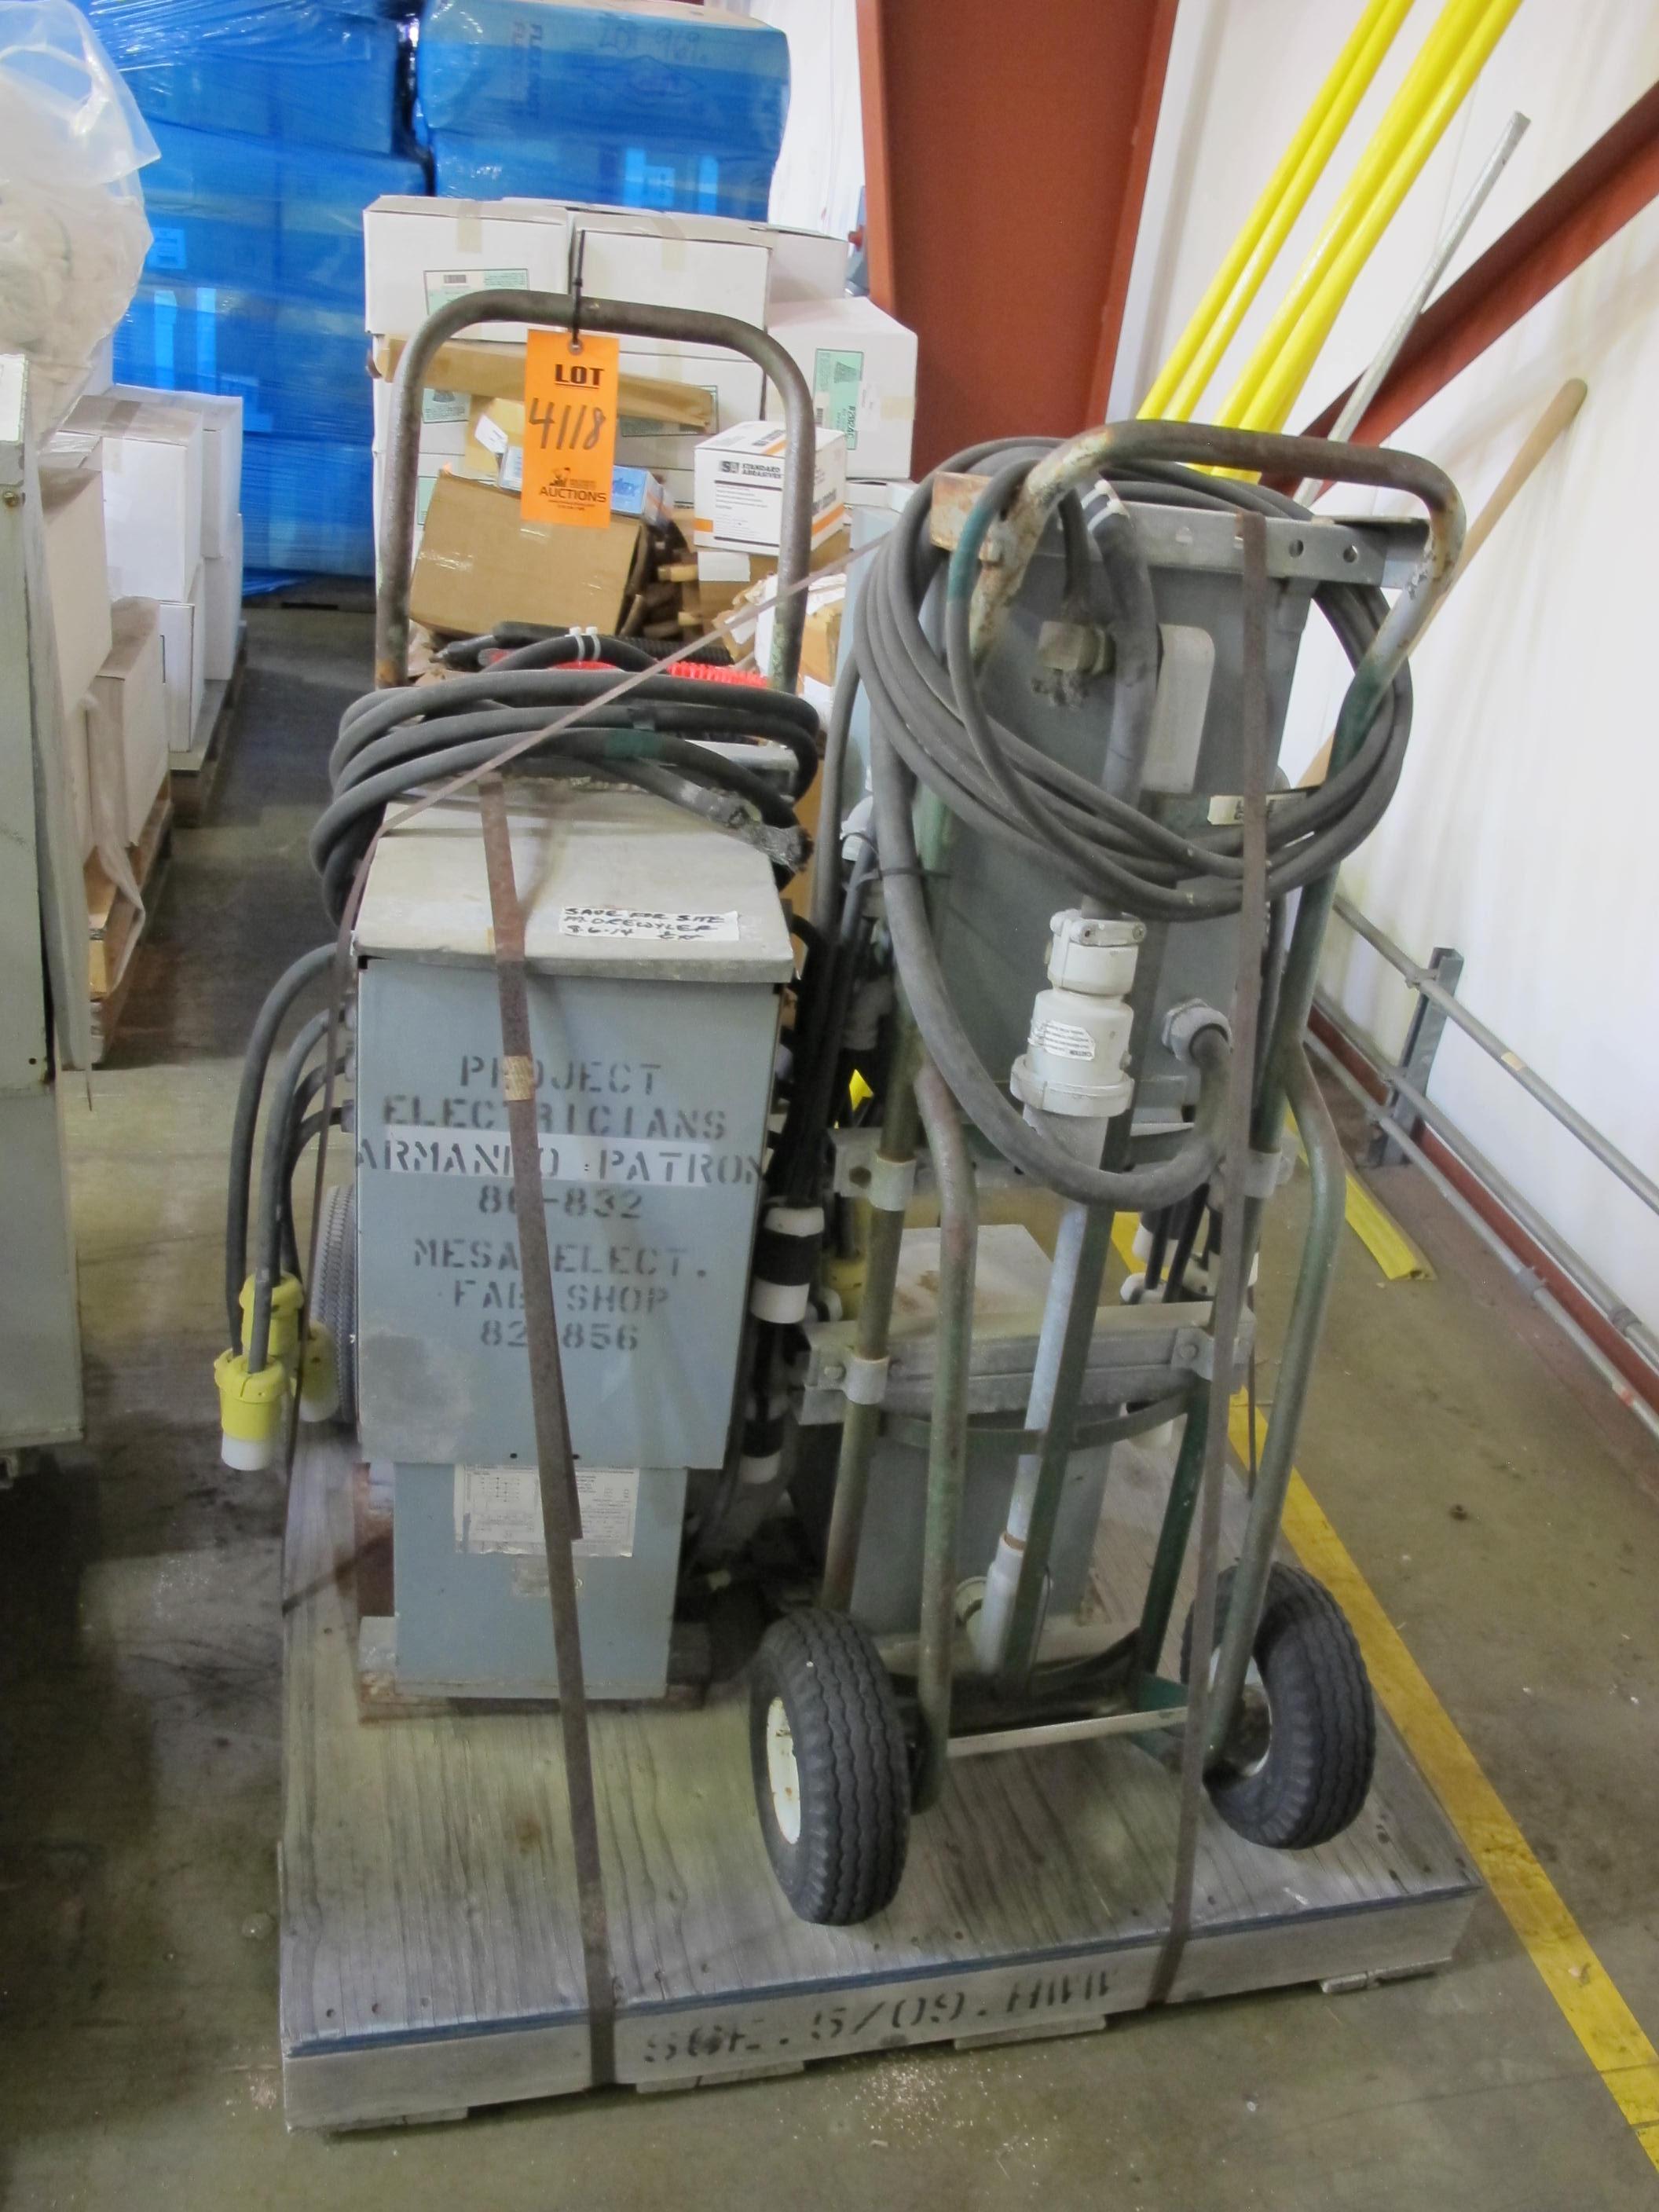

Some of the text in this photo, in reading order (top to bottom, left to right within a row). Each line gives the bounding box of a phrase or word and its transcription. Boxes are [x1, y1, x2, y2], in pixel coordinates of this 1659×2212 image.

[554, 363, 605, 386] LOT
[528, 397, 606, 451] 4118
[539, 485, 607, 504] AUCTIONS
[383, 1093, 726, 1140] ELECRICIANS
[413, 1237, 708, 1278] MESA ELECT.
[566, 1284, 670, 1313] SHOP
